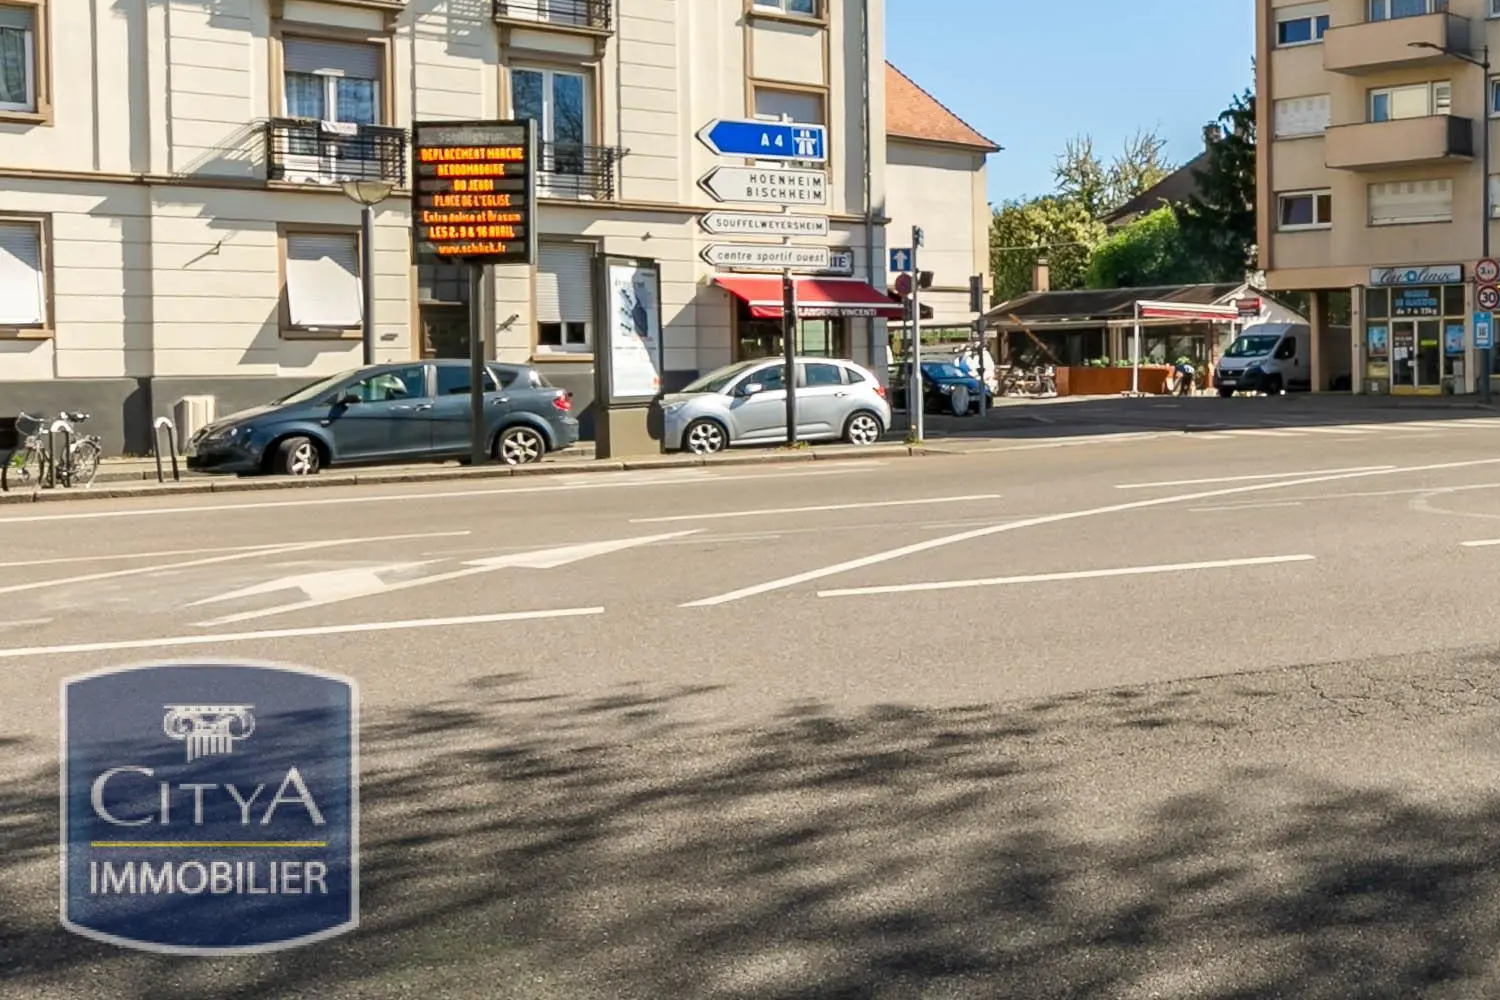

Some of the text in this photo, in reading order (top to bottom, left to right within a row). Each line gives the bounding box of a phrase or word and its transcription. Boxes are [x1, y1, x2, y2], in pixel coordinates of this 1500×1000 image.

[760, 132, 784, 148] A 4
[749, 173, 822, 187] HOENHEIM
[746, 186, 822, 200] BISCHHEIM
[433, 195, 460, 206] PLACE
[715, 218, 824, 231] SOUFFELWEYERSHEIM
[430, 226, 448, 238] LES
[717, 249, 826, 264] centre sportif ouest
[1482, 292, 1496, 303] 30
